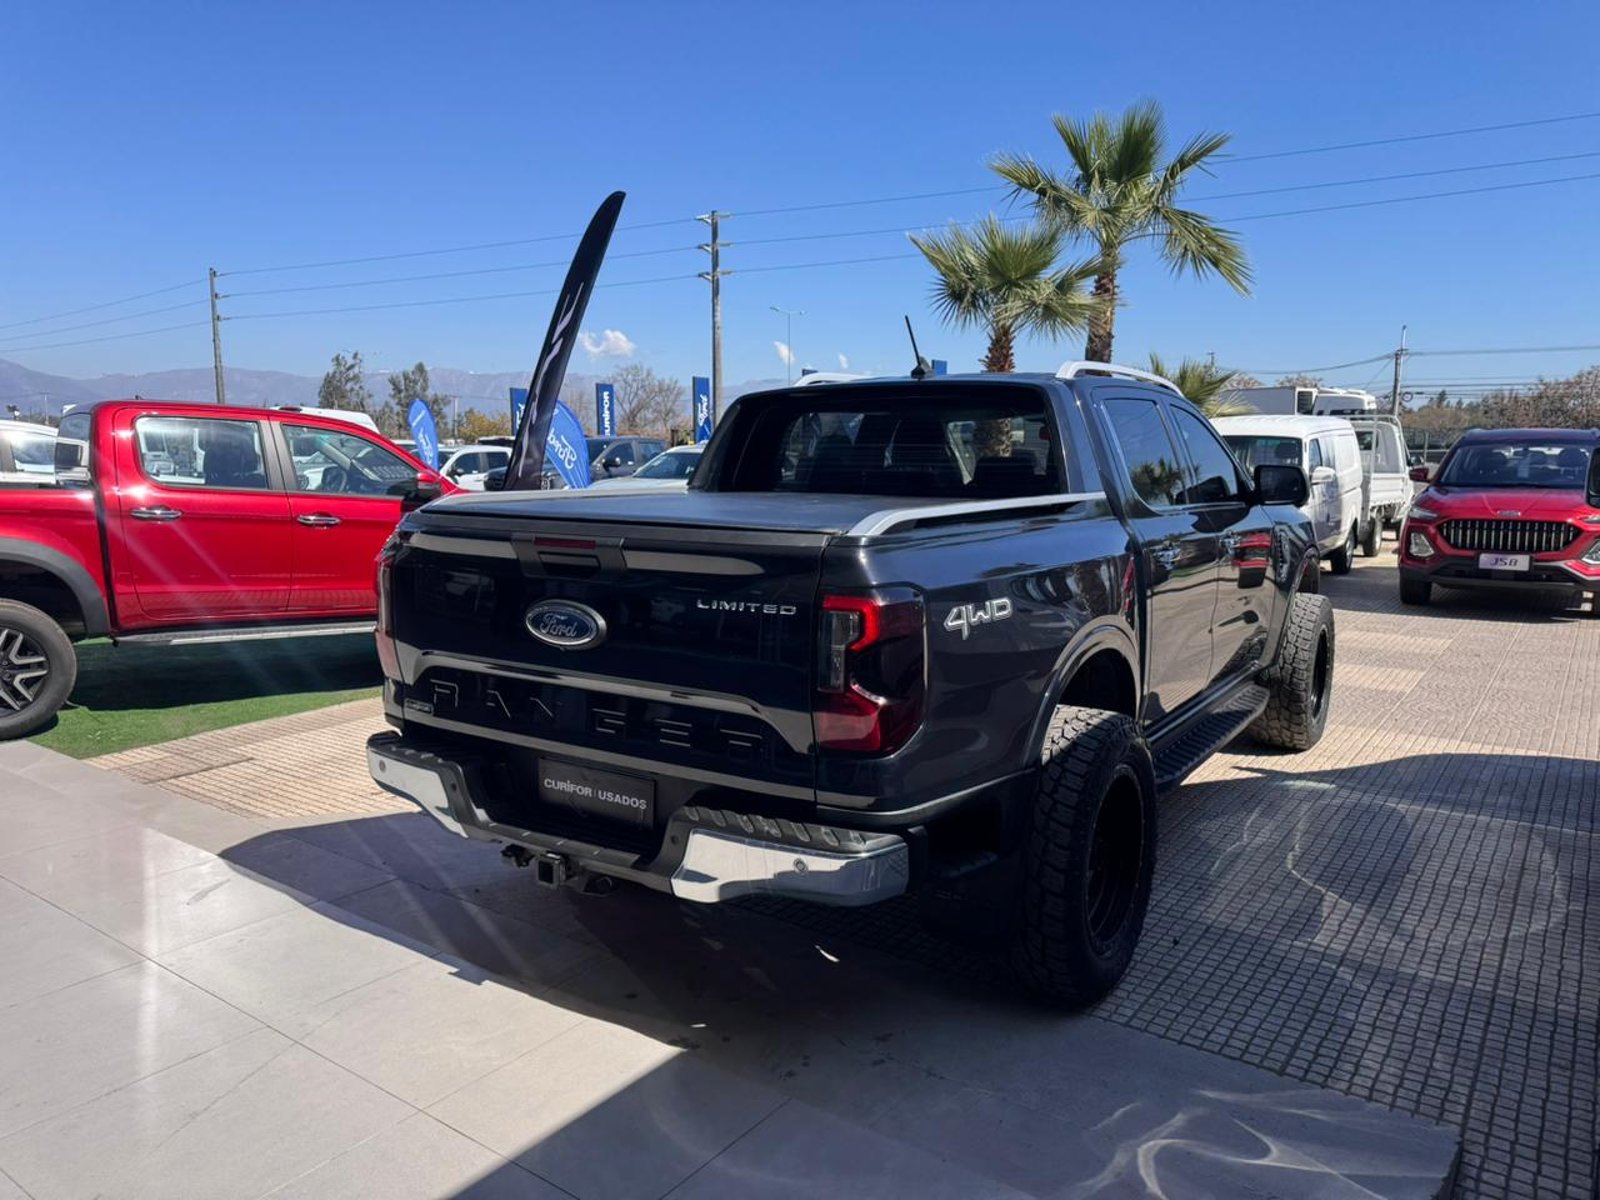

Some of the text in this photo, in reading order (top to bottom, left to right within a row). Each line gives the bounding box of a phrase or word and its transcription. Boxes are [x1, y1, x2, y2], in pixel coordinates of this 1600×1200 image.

[696, 599, 797, 615] LIMITED
[943, 597, 1013, 640] 4WD
[540, 612, 578, 638] Ford
[429, 678, 764, 754] RANGER
[598, 789, 648, 810] USADOS
